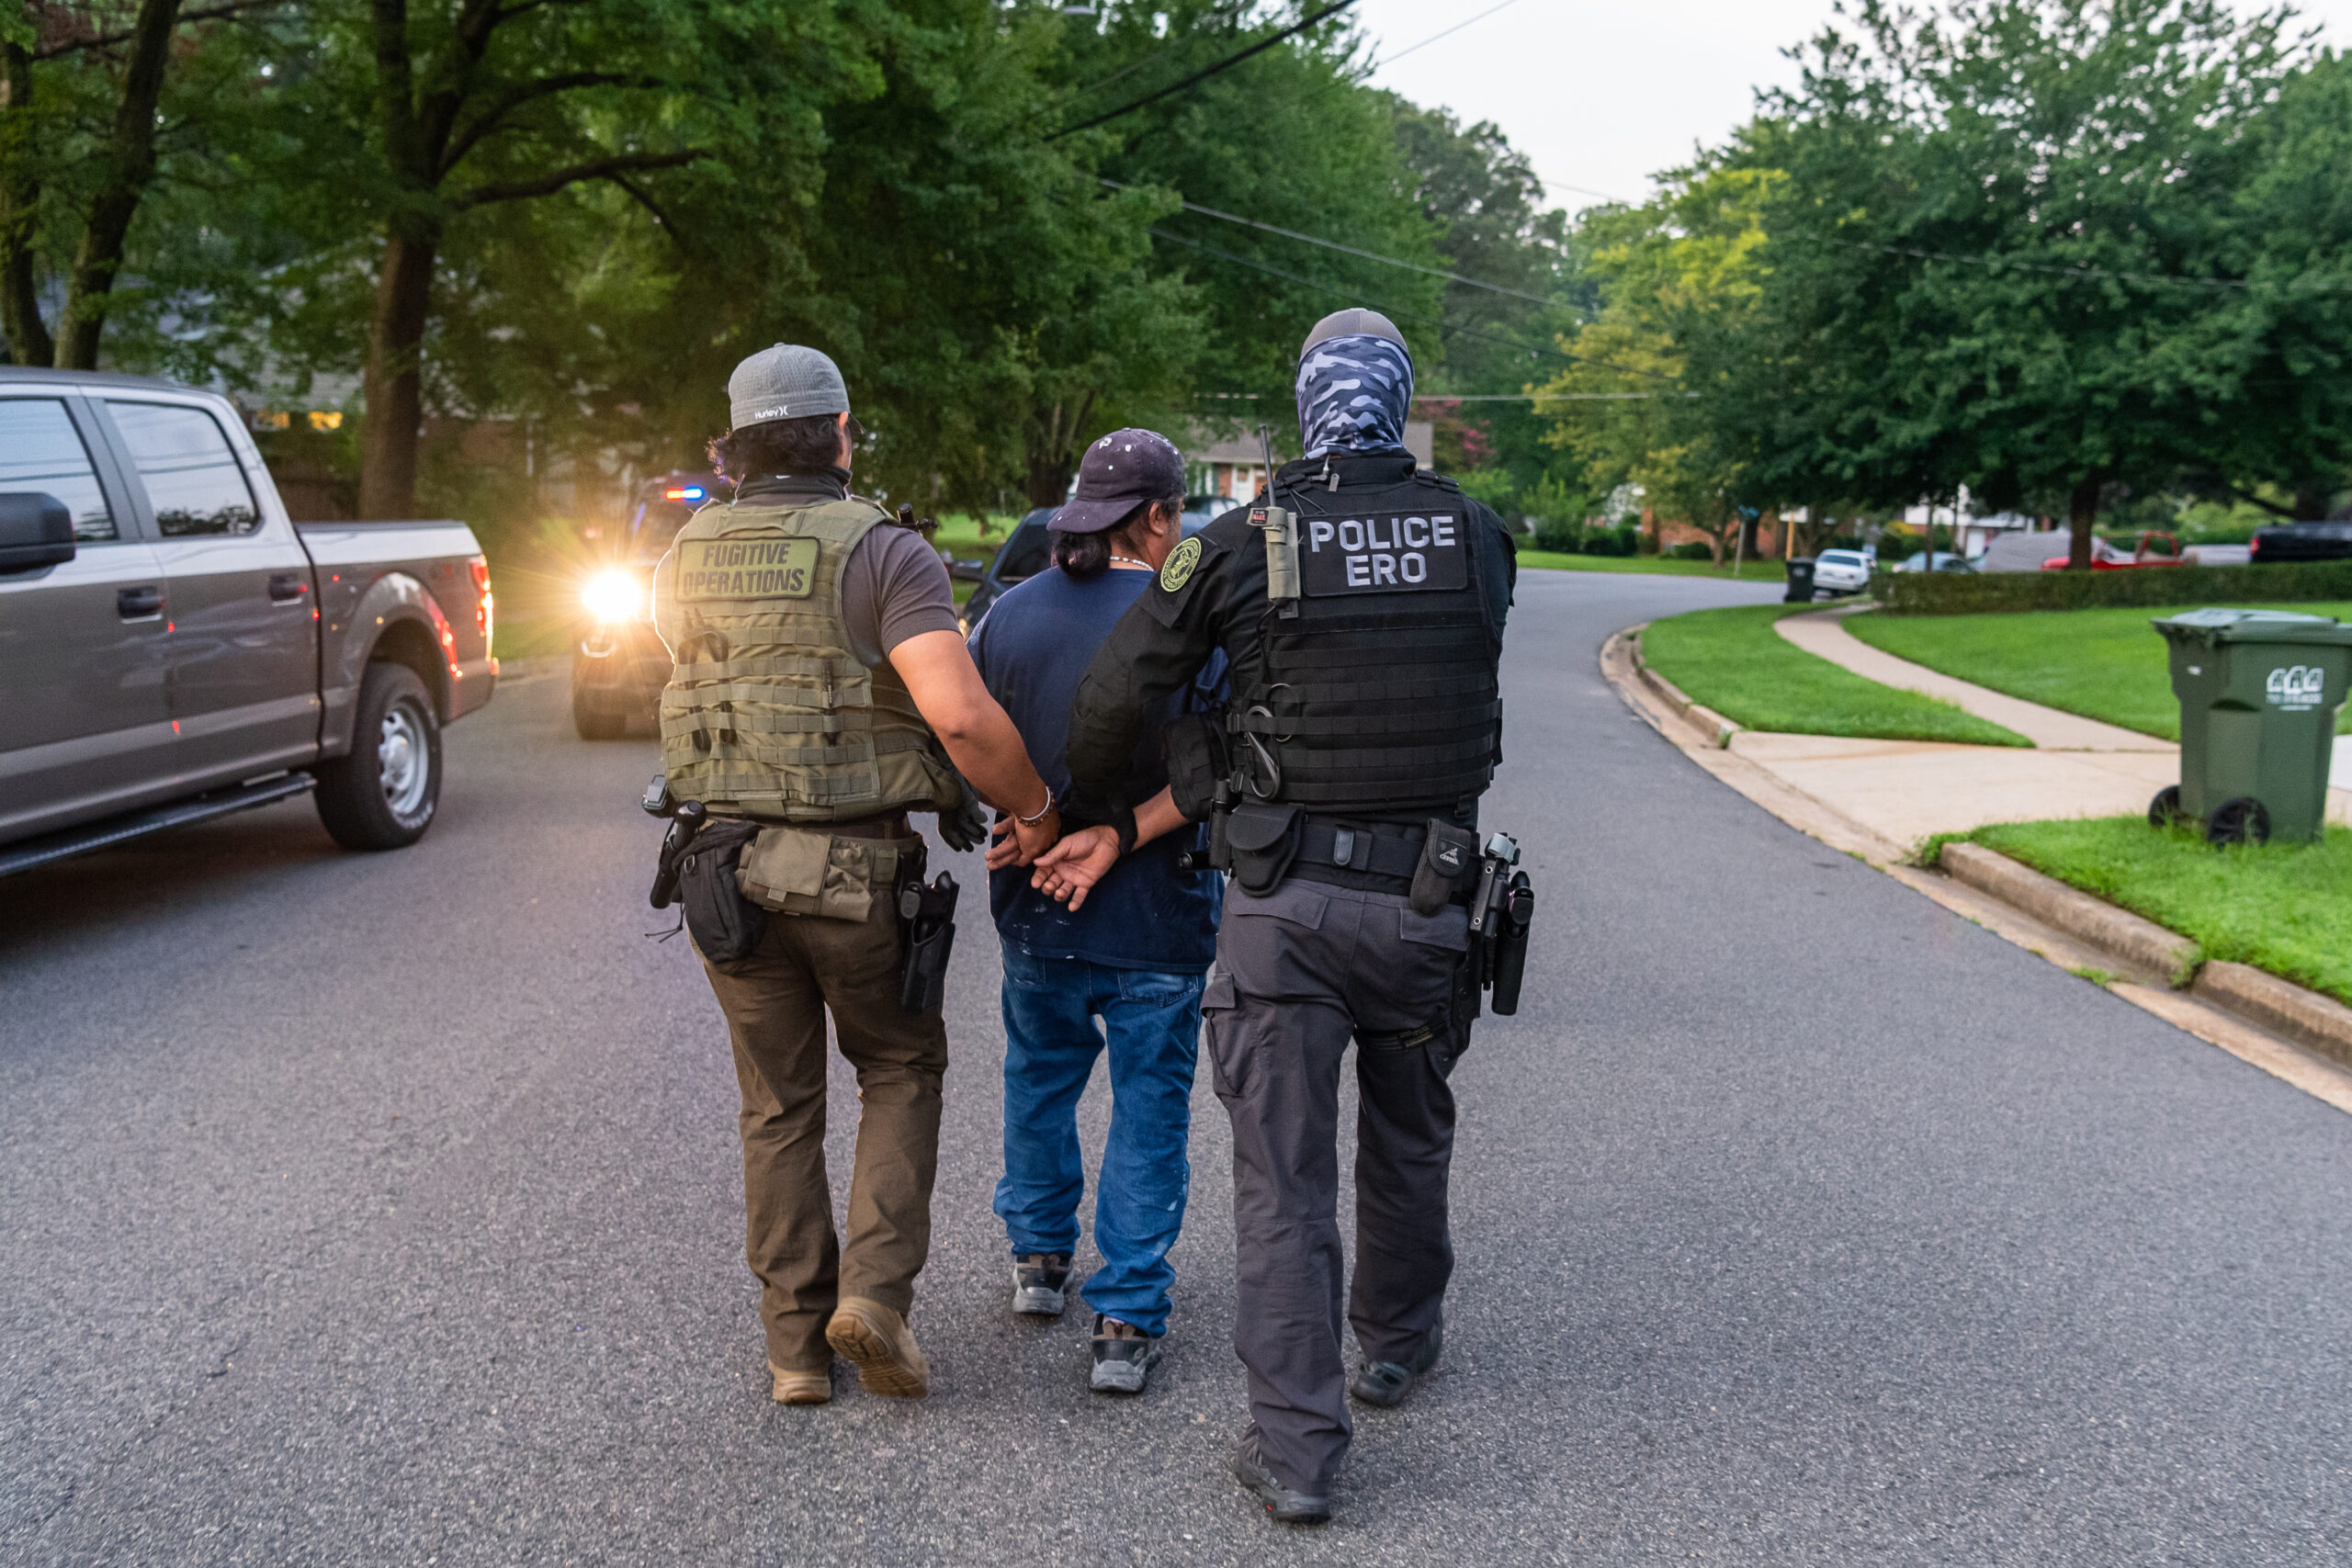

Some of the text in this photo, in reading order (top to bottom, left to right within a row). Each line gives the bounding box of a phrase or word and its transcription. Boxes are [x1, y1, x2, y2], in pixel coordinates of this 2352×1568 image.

[754, 408, 779, 420] Hurley
[1309, 515, 1455, 553] POLICE
[703, 543, 791, 568] FUGITIVE
[683, 569, 805, 596] OPERATIONS
[1346, 552, 1427, 587] ERO
